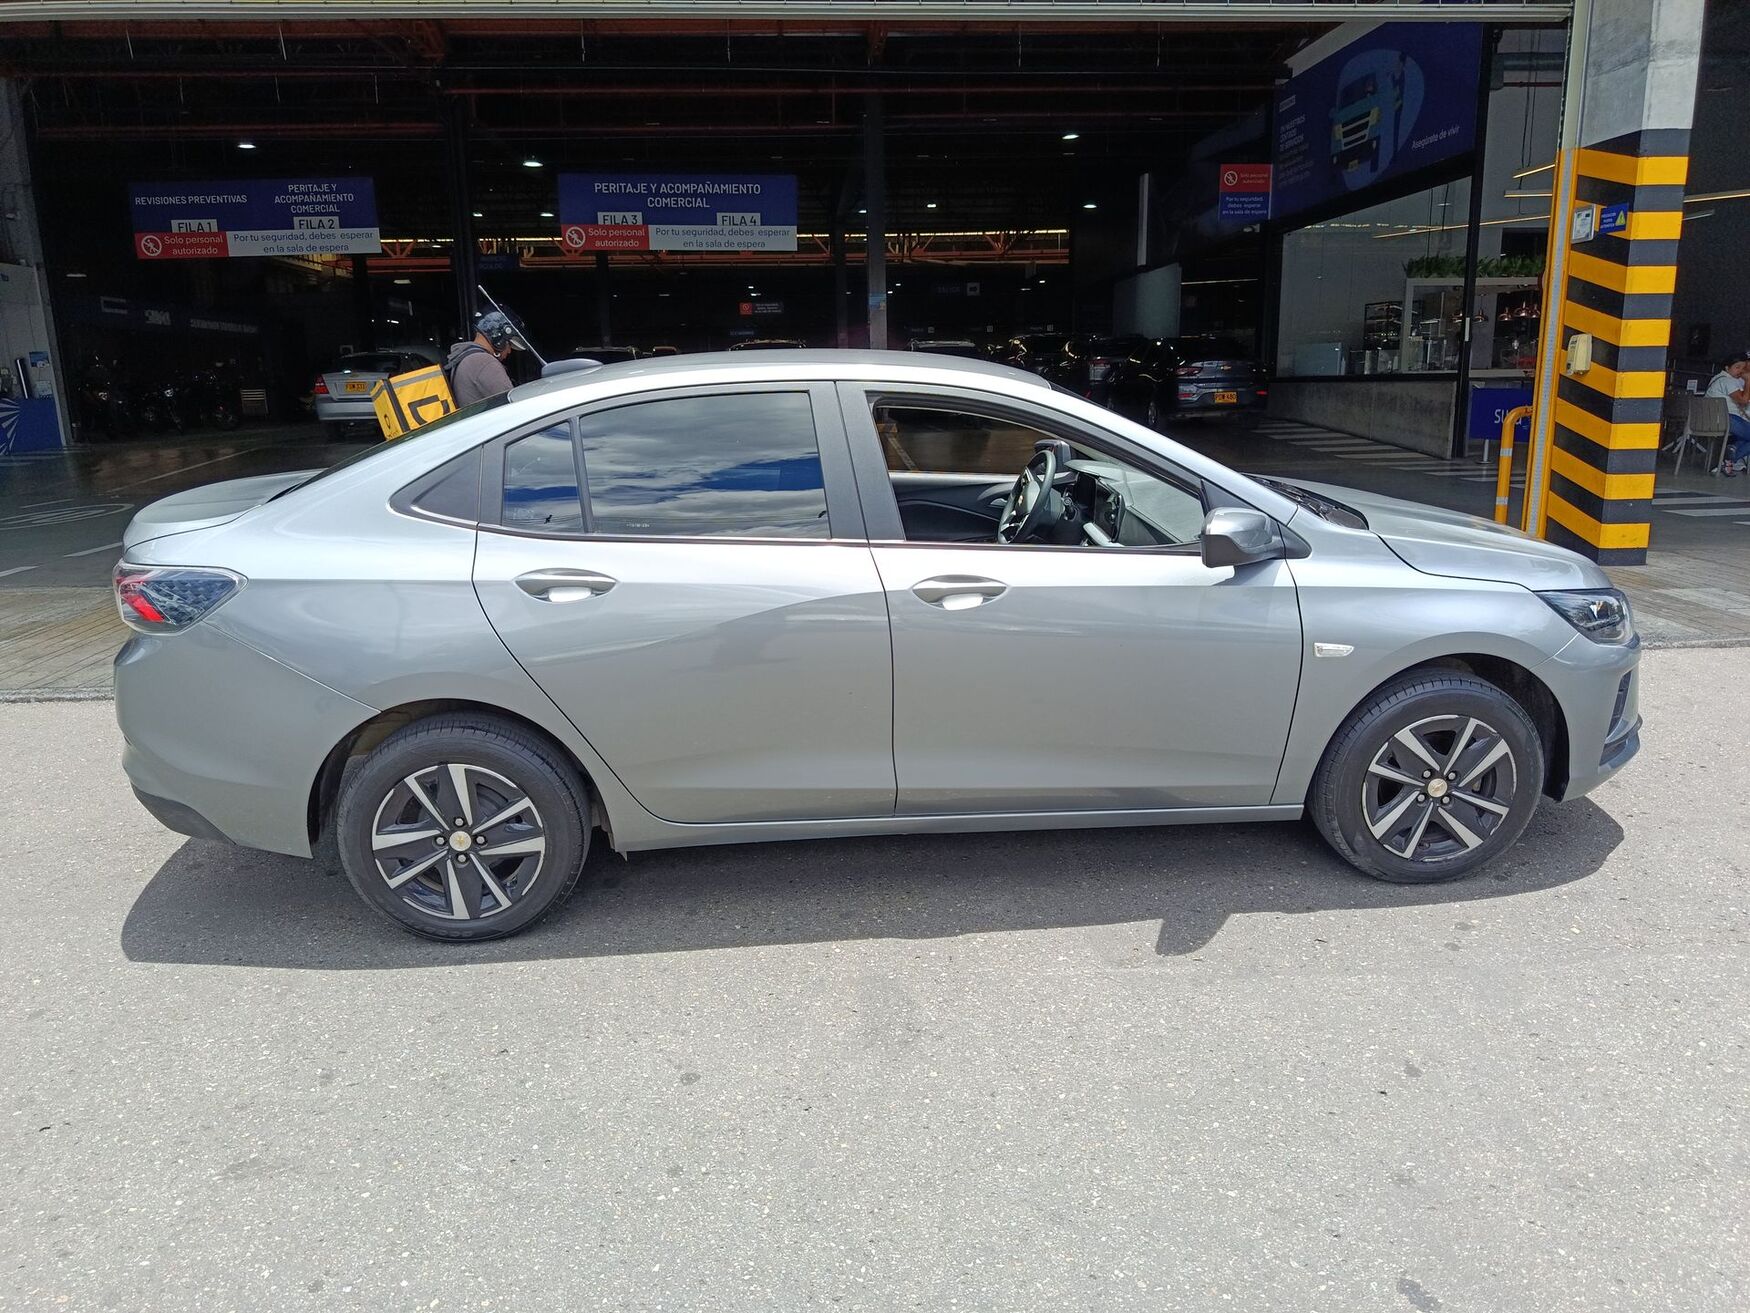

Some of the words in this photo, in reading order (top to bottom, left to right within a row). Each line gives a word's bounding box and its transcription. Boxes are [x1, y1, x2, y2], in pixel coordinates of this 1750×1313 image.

[288, 184, 330, 193] PERITAJE
[594, 183, 648, 193] PERITAJE
[650, 184, 657, 193] Y
[660, 181, 761, 194] ACOMPAÑAMIENTO
[135, 196, 187, 205] REVISIONES
[188, 195, 247, 203] PREVENTIVAS
[274, 191, 354, 203] ACOMPAÑAMIENTO
[647, 198, 710, 208] COMERCIAL
[291, 204, 340, 213] COMERCIAL
[299, 220, 326, 230] FILA
[328, 219, 335, 229] 2
[603, 215, 629, 225] FILA
[631, 215, 638, 224] 3
[722, 216, 747, 226] FILA
[749, 216, 757, 225] 4
[178, 223, 204, 232] FILA
[207, 222, 211, 232] 1
[234, 234, 249, 242] Por
[250, 234, 259, 242] tu
[309, 232, 336, 240] debes
[340, 232, 373, 240] esperar
[588, 228, 607, 236] Solo
[609, 228, 645, 238] personal
[682, 227, 726, 238] seguridad,
[728, 228, 755, 236] debes
[758, 228, 789, 237] esperar
[164, 236, 183, 244] Solo
[185, 236, 223, 245] personal
[595, 239, 639, 247] autorizado
[696, 239, 704, 247] la
[706, 239, 722, 247] sala
[724, 239, 735, 247] de
[738, 240, 766, 249] espera
[172, 247, 218, 255] autorizado
[264, 245, 274, 253] en
[286, 244, 303, 252] sala
[320, 244, 349, 253] espera
